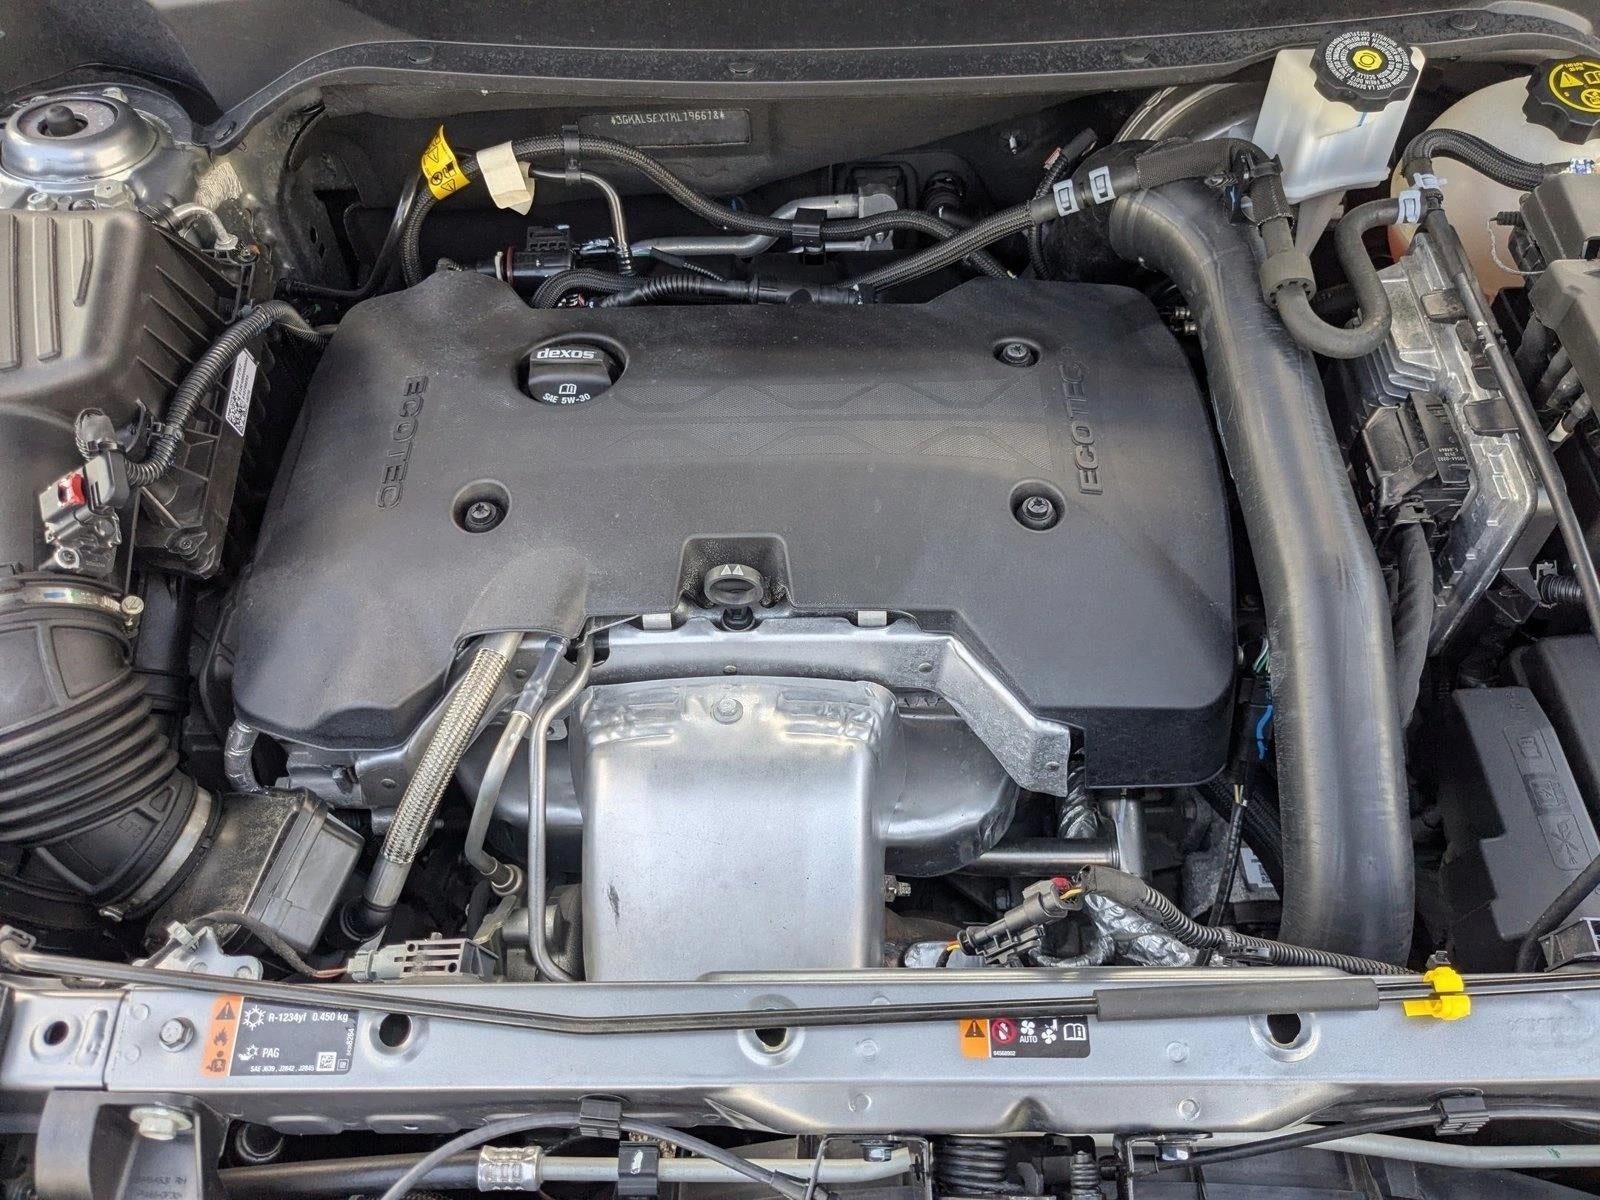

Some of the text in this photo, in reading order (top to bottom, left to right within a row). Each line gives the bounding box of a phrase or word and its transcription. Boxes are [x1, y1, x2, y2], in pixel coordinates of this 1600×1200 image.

[537, 348, 594, 359] dexos
[543, 392, 591, 404] SAE 5W-30
[1060, 362, 1104, 495] ECOTEC
[377, 375, 429, 510] ECOTEC
[268, 1012, 349, 1023] R-1234yf 0.450 kg
[1019, 1035, 1038, 1044] AUTO
[262, 1048, 280, 1058] PAG
